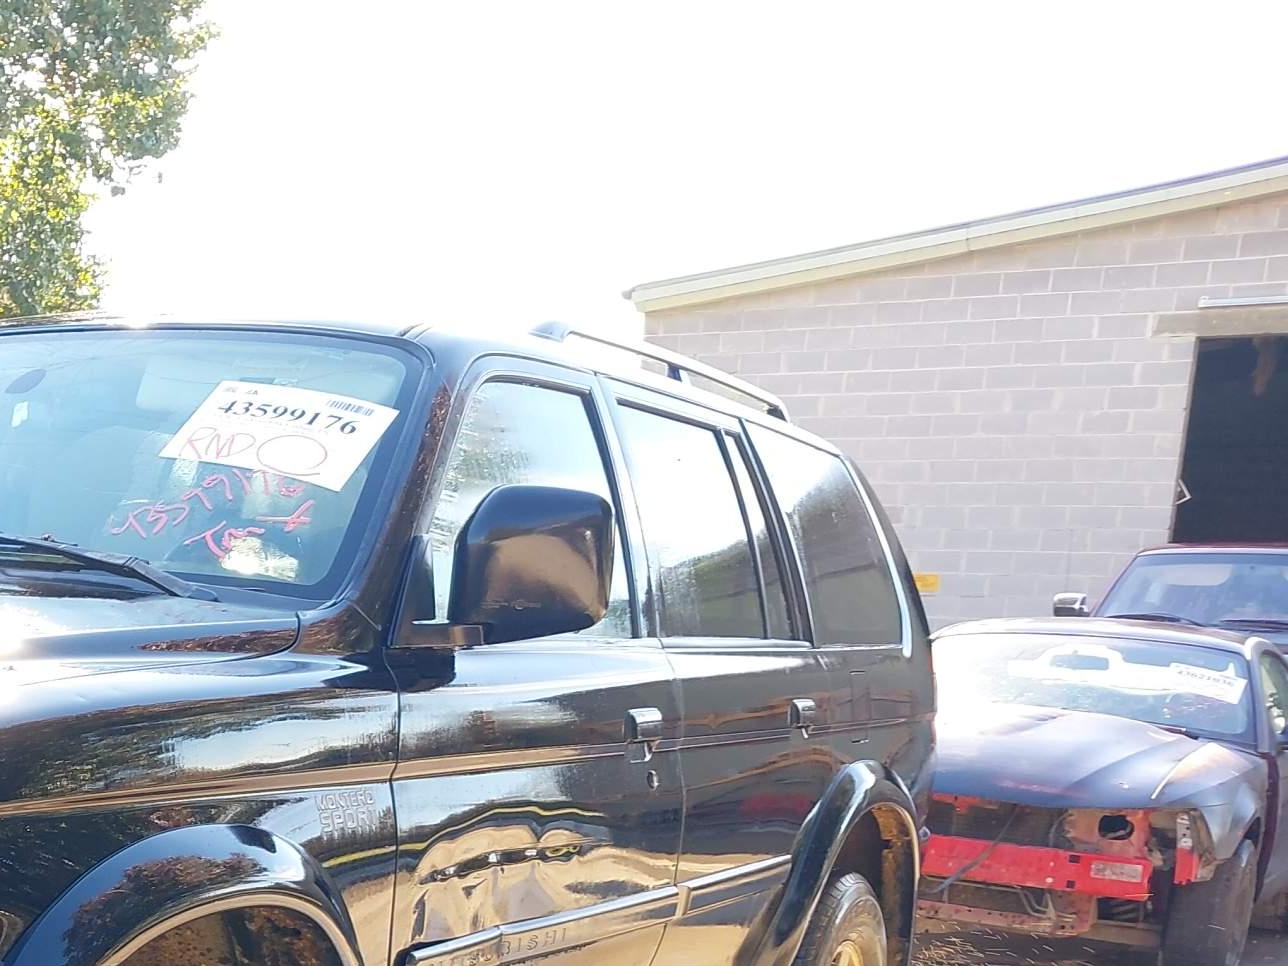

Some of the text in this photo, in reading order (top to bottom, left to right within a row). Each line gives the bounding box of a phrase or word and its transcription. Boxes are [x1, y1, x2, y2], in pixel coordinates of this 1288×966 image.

[218, 399, 360, 435] 43599176
[315, 789, 376, 812] MONTERO
[319, 806, 378, 833] SPORT
